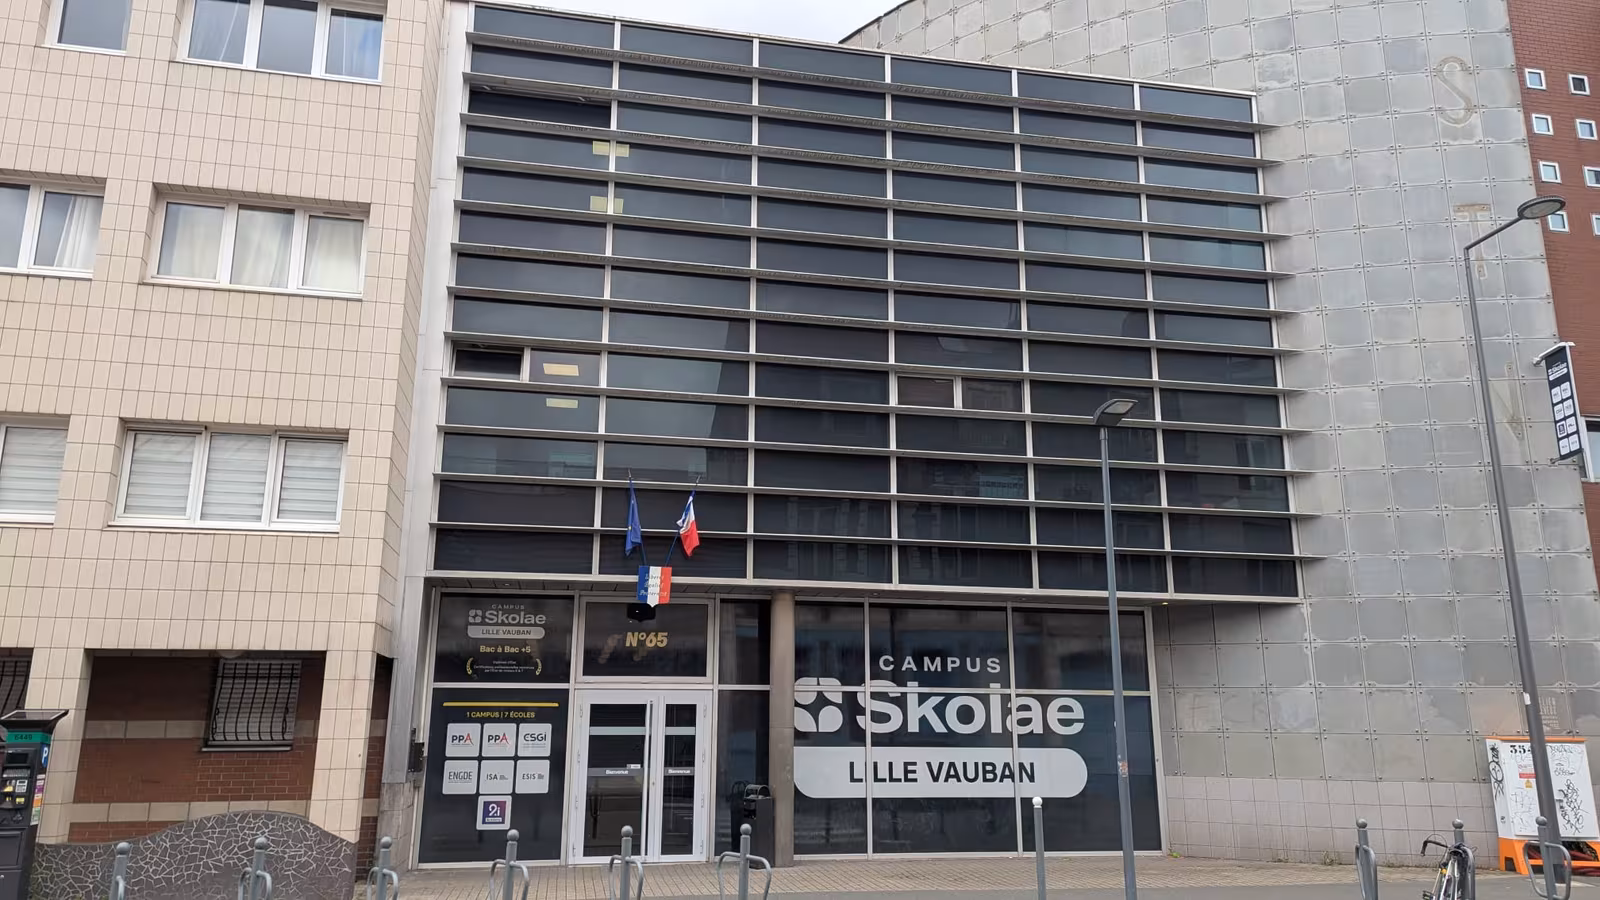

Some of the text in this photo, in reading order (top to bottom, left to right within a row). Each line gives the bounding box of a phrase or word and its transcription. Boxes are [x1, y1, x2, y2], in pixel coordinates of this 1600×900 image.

[485, 610, 546, 624] Skolae
[480, 645, 496, 653] Bac
[504, 645, 520, 653] Bac
[521, 645, 531, 653] +5
[879, 655, 1001, 673] CAMPUS
[856, 679, 1085, 735] Skolae
[509, 710, 536, 719] ÉCOLES
[451, 732, 475, 746] PPA
[487, 732, 510, 745] PPA
[41, 746, 49, 765] P
[1510, 744, 1532, 755] 35
[448, 771, 473, 780] ENGDE
[486, 773, 498, 781] ISA
[849, 761, 1036, 783] LLLE VAUBAN
